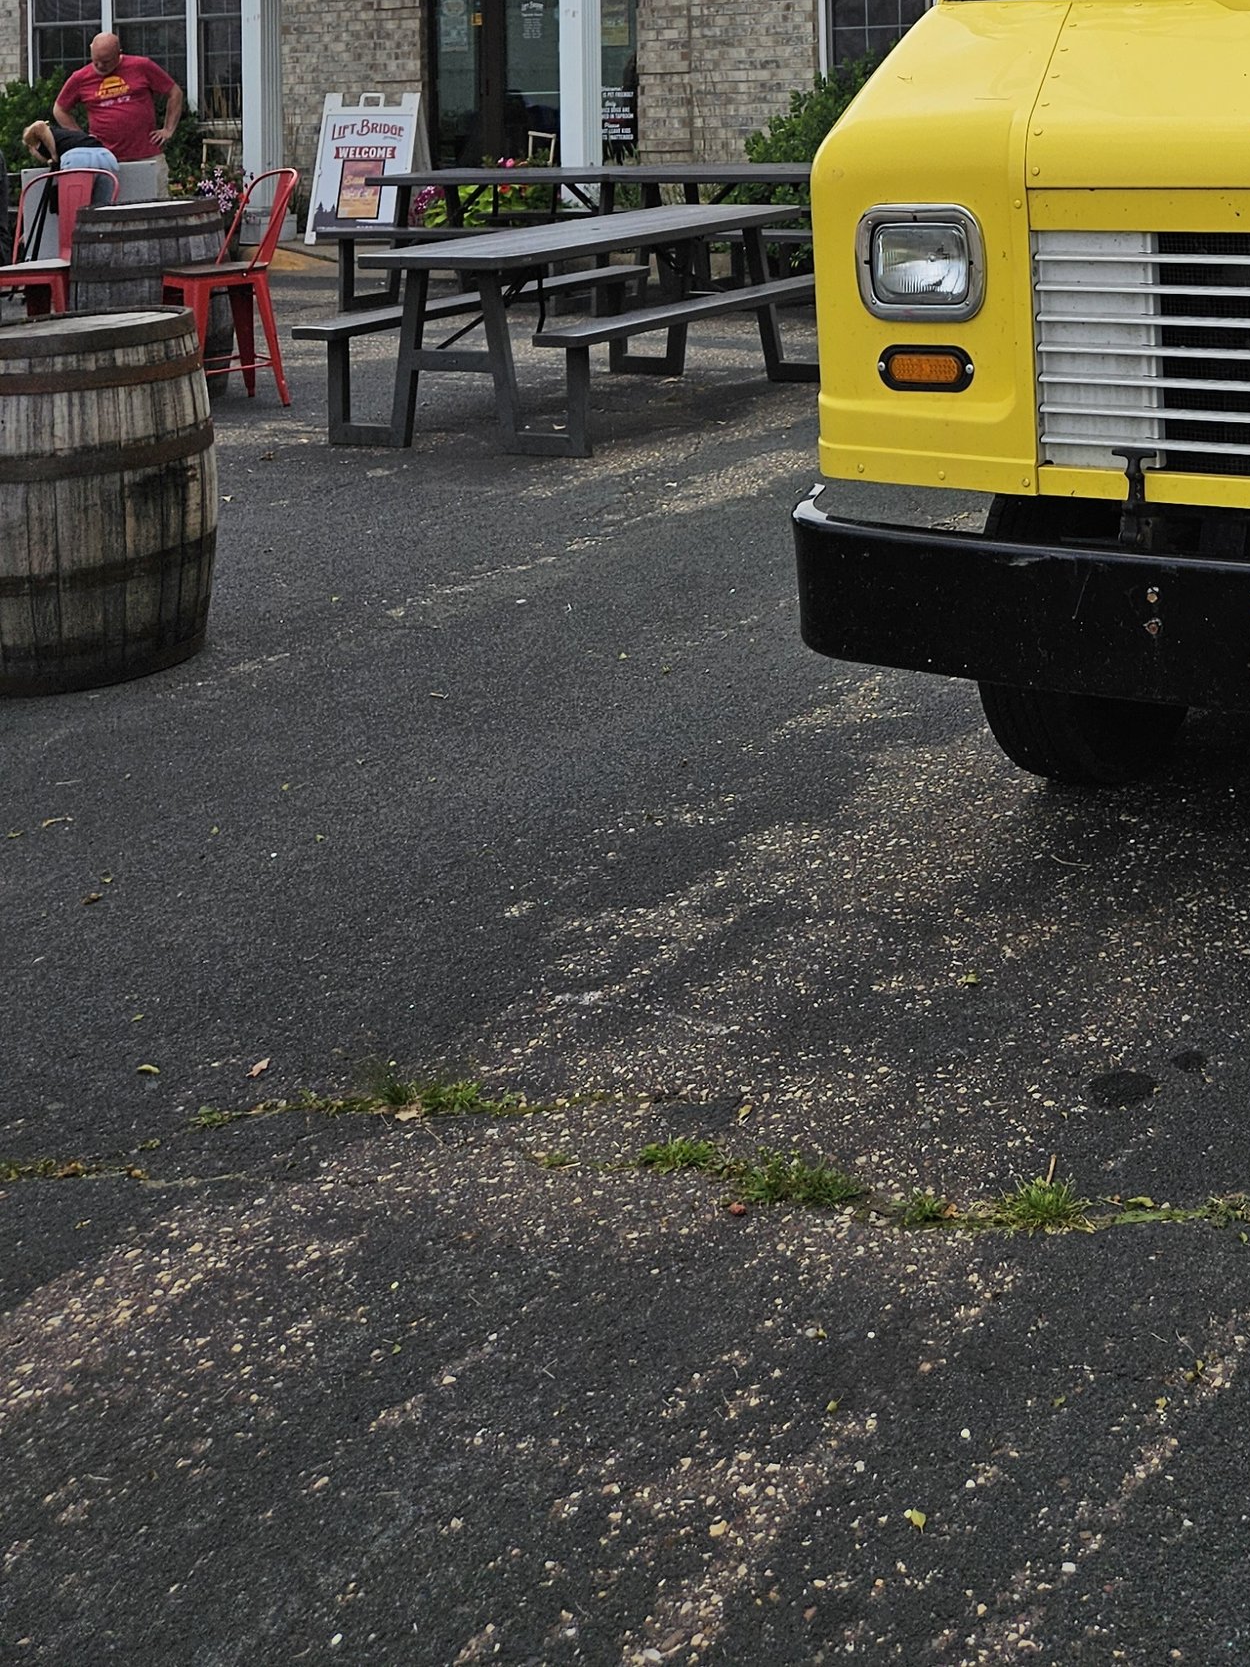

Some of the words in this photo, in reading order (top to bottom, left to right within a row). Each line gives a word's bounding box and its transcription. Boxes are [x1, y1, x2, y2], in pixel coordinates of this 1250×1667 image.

[331, 123, 357, 141] LIFT
[356, 118, 405, 138] BRIDGE
[338, 146, 393, 159] WELCOME
